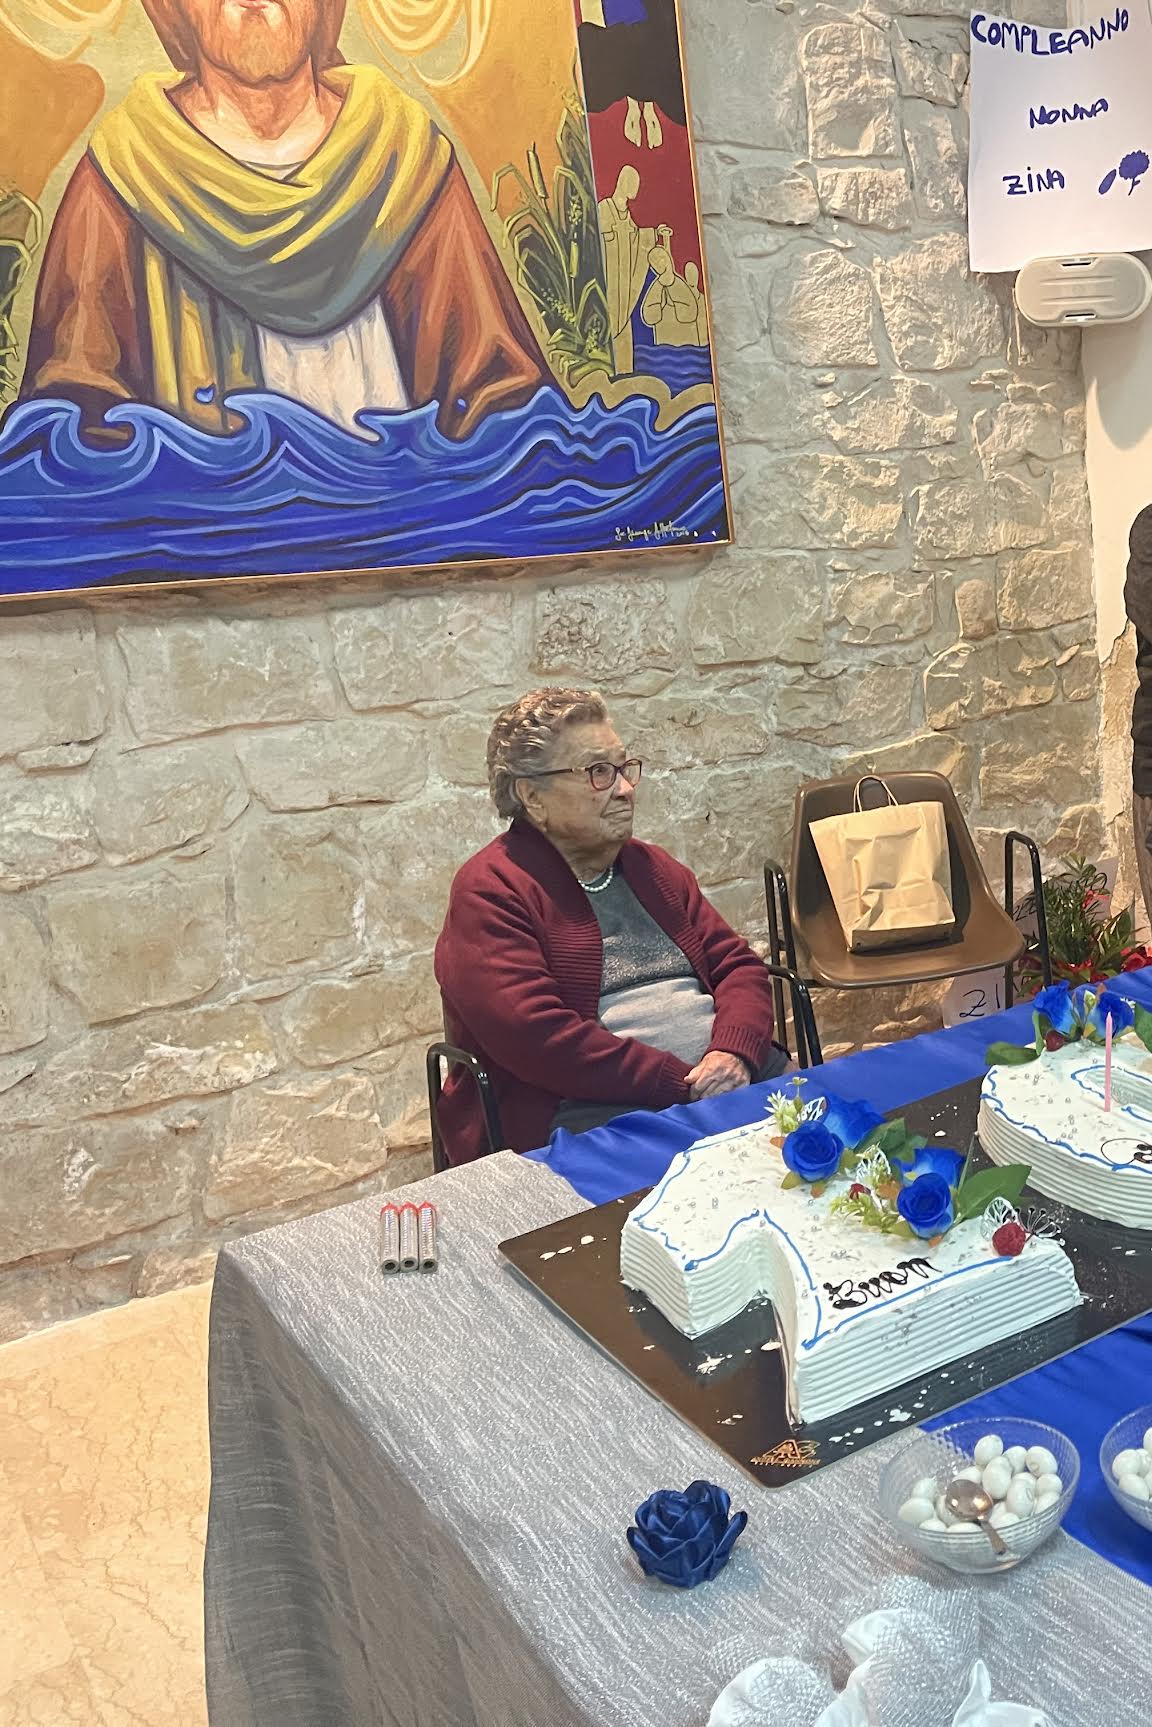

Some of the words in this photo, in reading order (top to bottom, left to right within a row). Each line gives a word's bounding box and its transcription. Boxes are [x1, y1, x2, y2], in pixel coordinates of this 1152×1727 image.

[971, 8, 1129, 56] COMPLEANNO
[1029, 98, 1109, 129] NONNA
[822, 1256, 943, 1310] Buon
